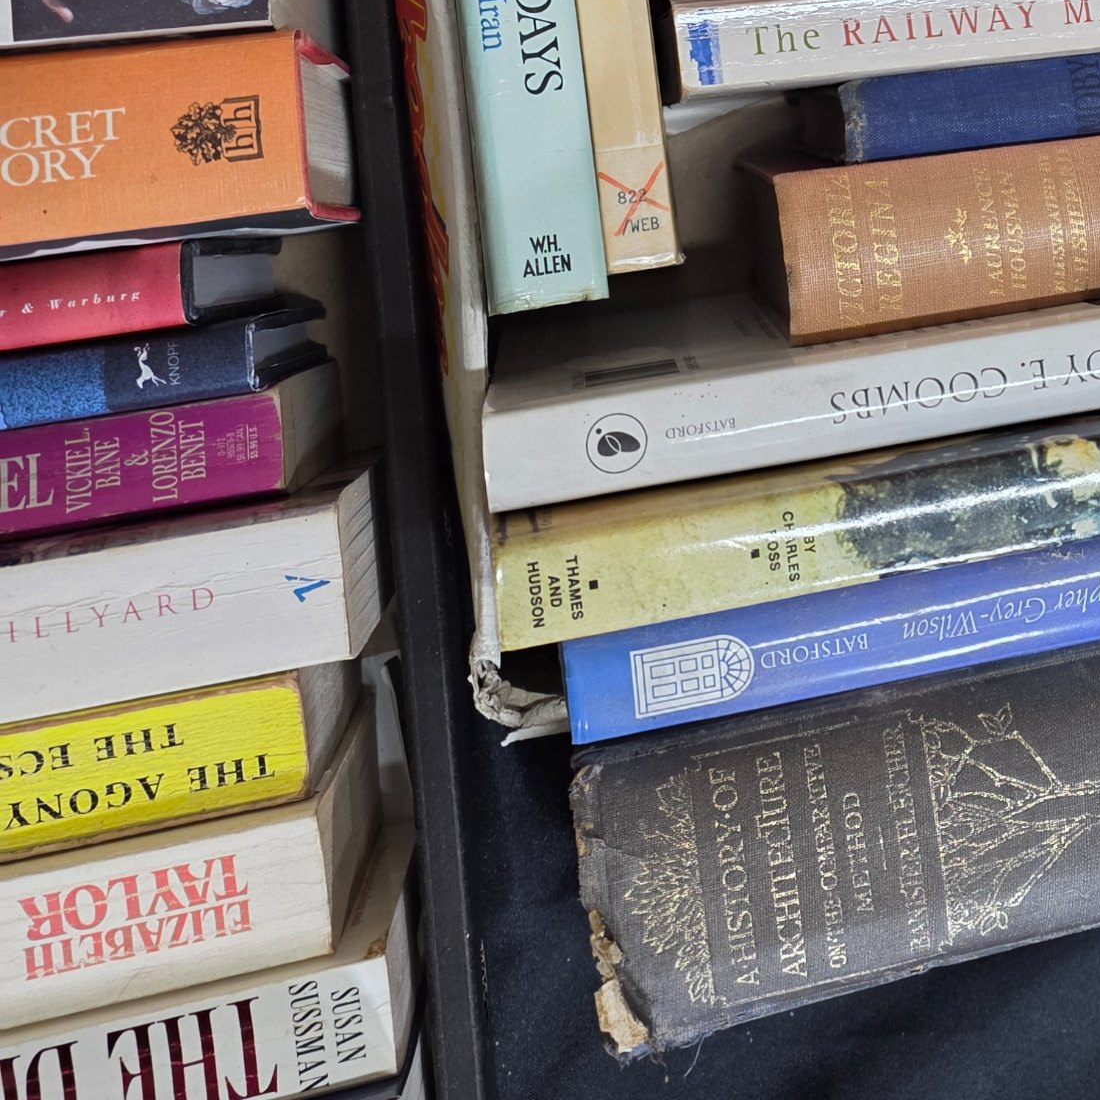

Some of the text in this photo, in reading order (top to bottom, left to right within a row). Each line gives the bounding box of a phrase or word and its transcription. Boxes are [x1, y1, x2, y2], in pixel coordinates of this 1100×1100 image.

[746, 25, 821, 56] The
[842, 0, 1036, 47] RAILWAY
[618, 189, 648, 205] 822
[523, 254, 572, 278] ALLEN
[529, 235, 562, 253] W.H.
[21, 303, 33, 314] &
[50, 290, 141, 311] Warburg
[168, 340, 182, 387] KNOPF
[1020, 358, 1049, 391] E.
[830, 366, 1008, 425] COOMBS
[179, 420, 206, 482] BENET
[665, 416, 737, 441] BATSFORD
[65, 453, 92, 514] VICKIE
[95, 436, 121, 490] BANE
[124, 450, 149, 467] &
[150, 411, 178, 503] LORENZO
[527, 561, 545, 628] HUDSON
[548, 576, 561, 608] AND
[566, 555, 584, 621] THAMES
[902, 596, 1046, 642] Grey-Wilson
[761, 633, 868, 668] BATSFORD
[93, 723, 185, 762] THE
[5, 753, 276, 831] THE AGONY
[753, 751, 808, 977] ARCHITECTURE
[842, 792, 874, 913] METHOD
[17, 854, 249, 941] TAYLOR
[24, 899, 253, 982] ELIZABETH
[288, 980, 329, 1092] SUSSMAN
[330, 986, 366, 1064] SUSAN
